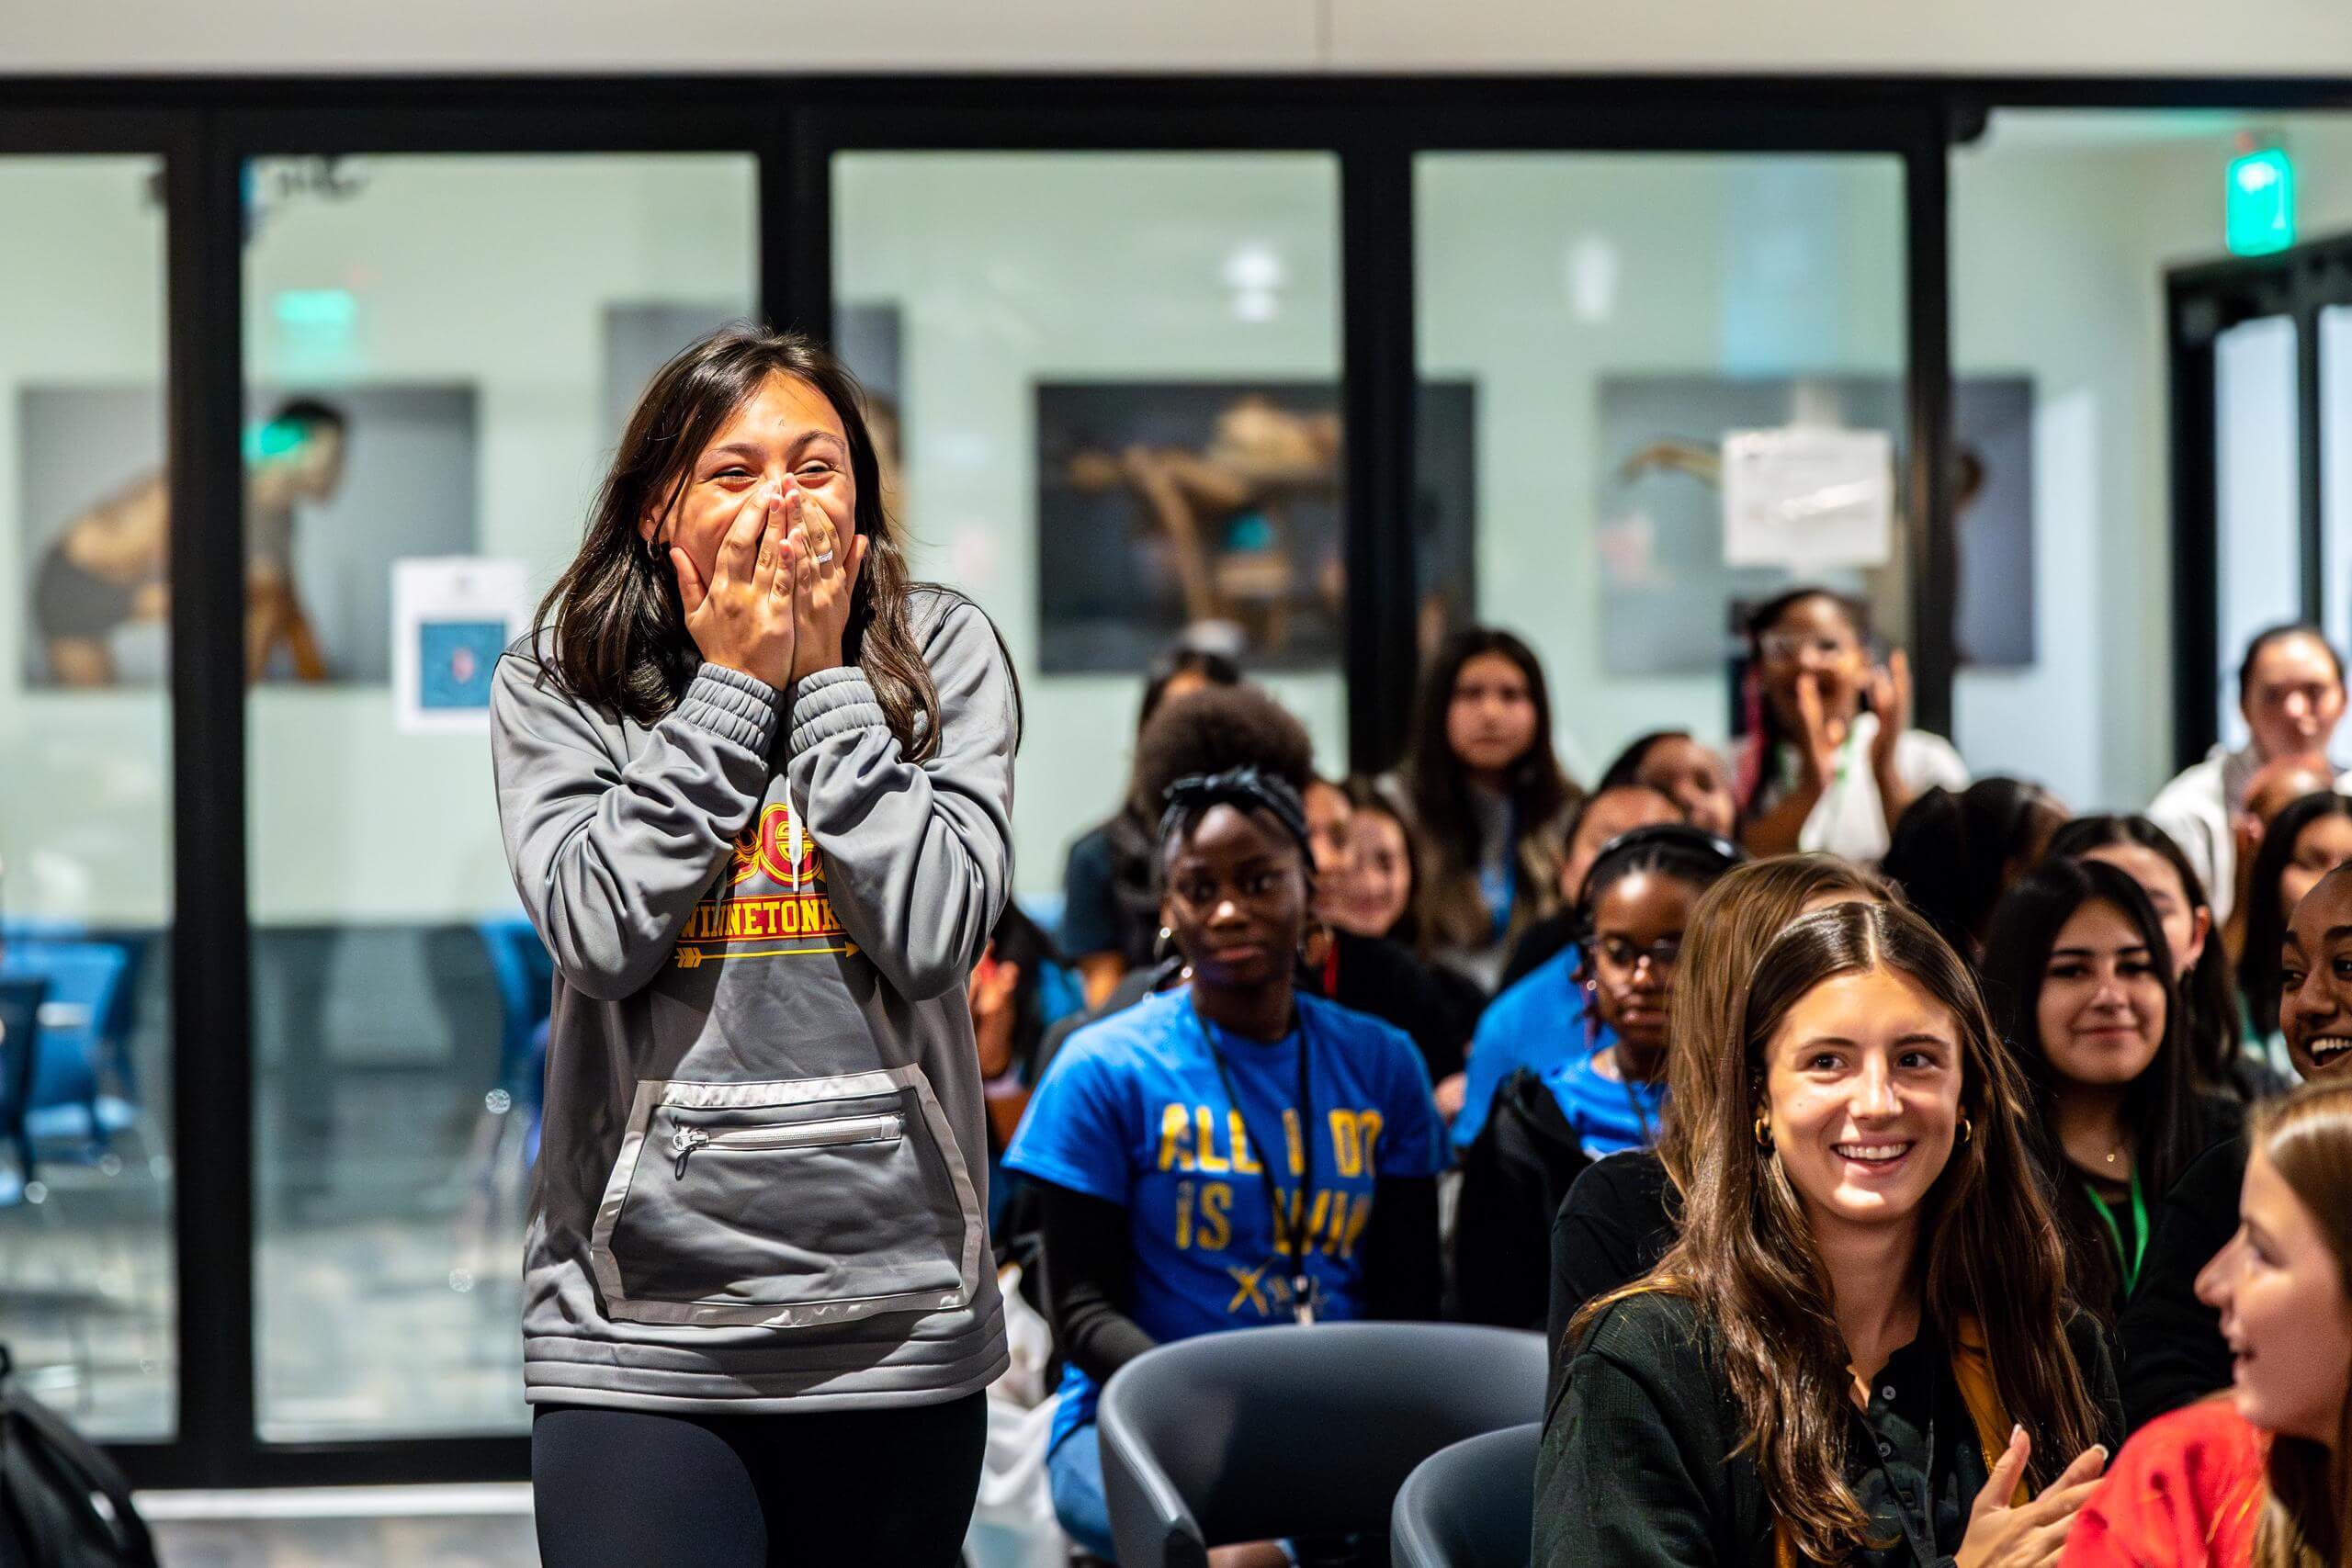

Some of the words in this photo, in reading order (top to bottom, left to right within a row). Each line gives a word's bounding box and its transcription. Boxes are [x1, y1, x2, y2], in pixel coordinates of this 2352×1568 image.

[1158, 1103, 1263, 1174] ALL
[1282, 1108, 1305, 1177] I
[1175, 1180, 1233, 1250] IS
